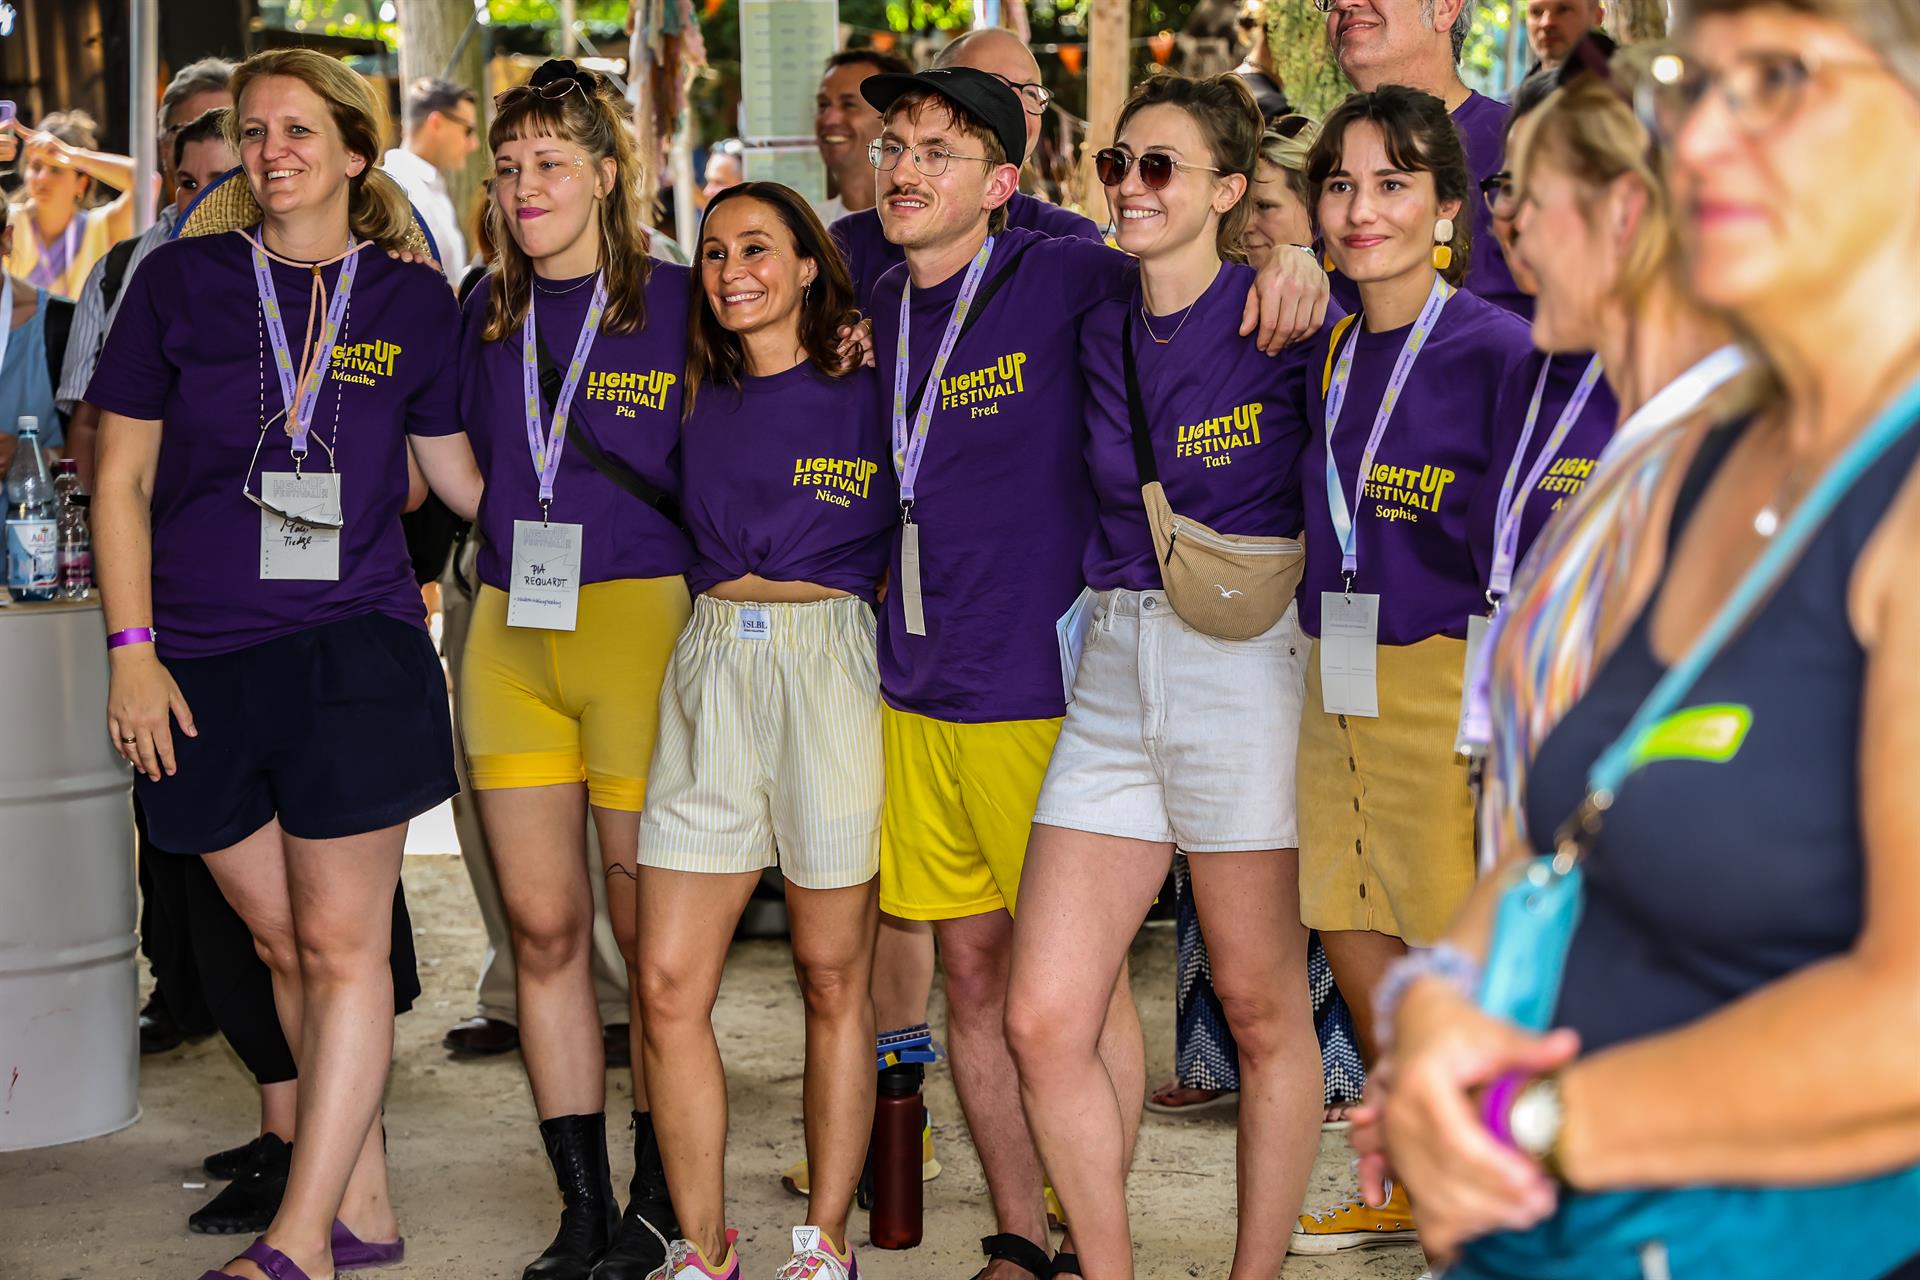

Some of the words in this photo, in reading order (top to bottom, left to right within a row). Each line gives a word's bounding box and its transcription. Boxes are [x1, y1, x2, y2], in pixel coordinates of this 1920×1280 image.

[326, 357, 385, 375] STIVAL
[331, 369, 376, 387] Maaike
[586, 387, 657, 409] FESTIVAL
[942, 382, 1015, 411] FESTIVAL
[615, 405, 636, 418] Pia
[970, 402, 999, 419] Fred
[1176, 432, 1252, 458] FESTIVAL
[1202, 452, 1232, 469] Tati
[1548, 458, 1597, 478] LIGH
[793, 473, 861, 496] FESTIVAL
[1537, 475, 1584, 495] FESTI
[815, 488, 851, 508] Nicole
[1364, 483, 1429, 510] FESTIVAL
[1375, 504, 1418, 522] Sophie
[530, 563, 546, 575] PIA
